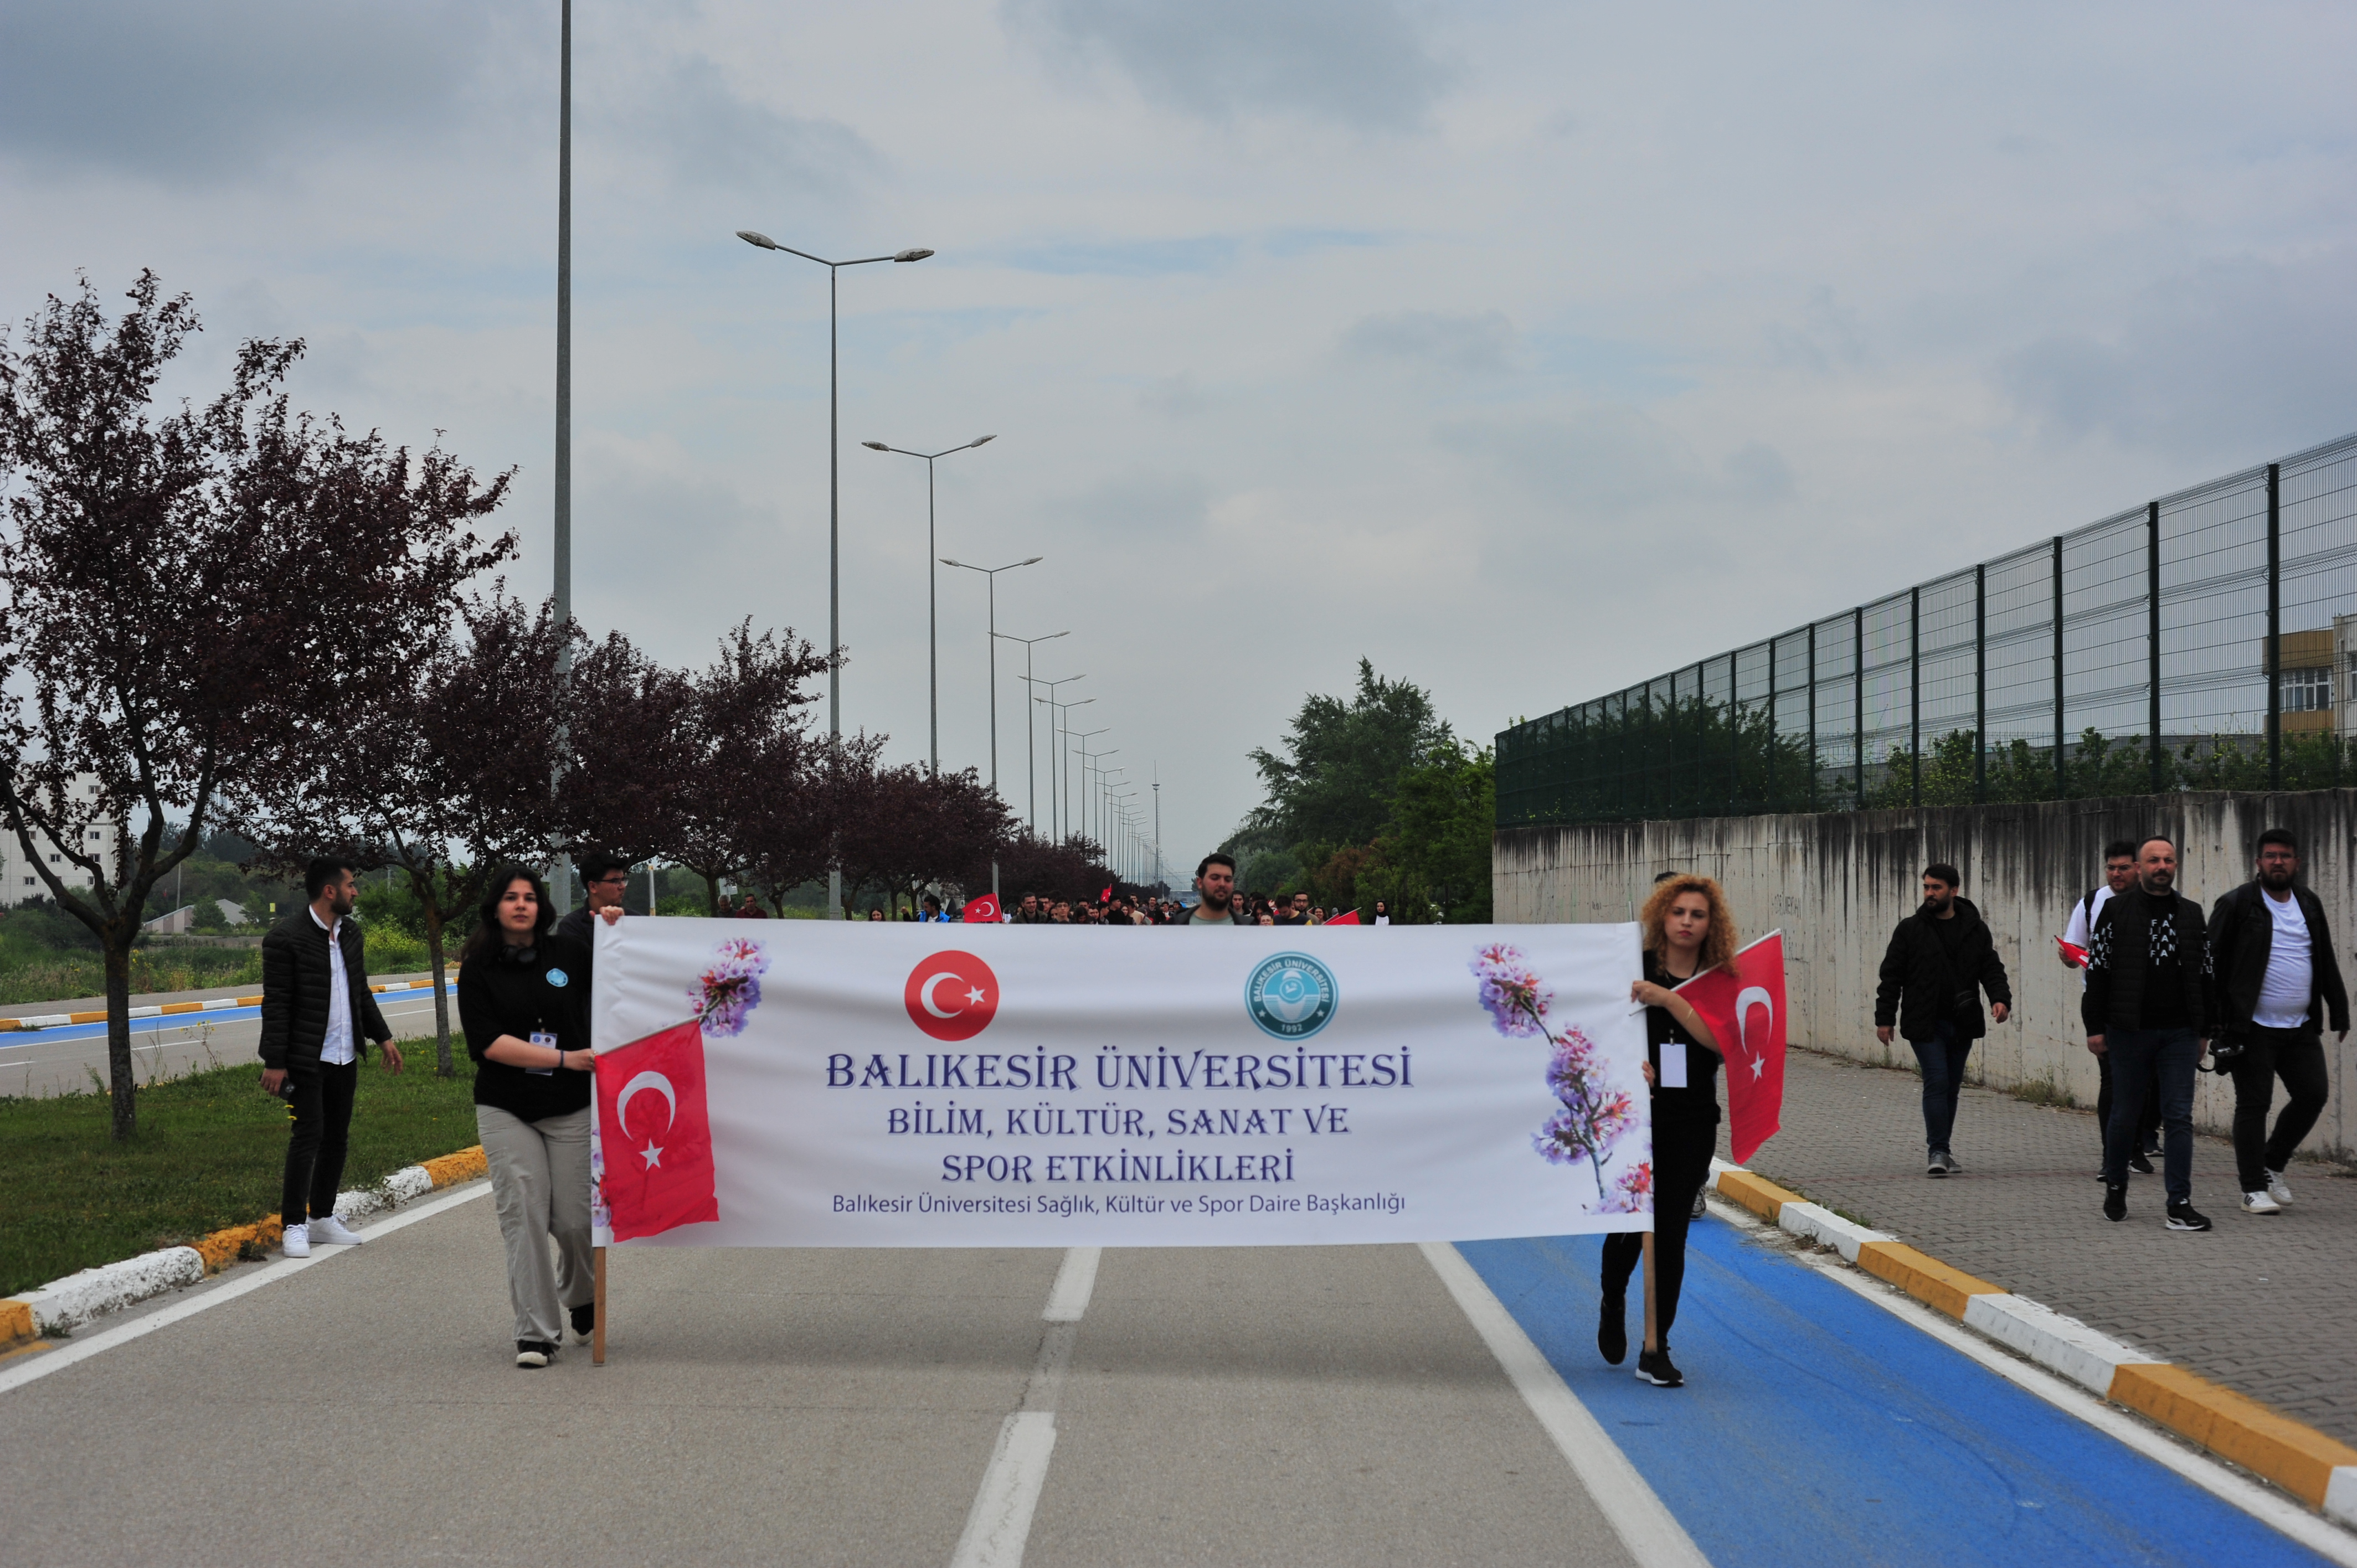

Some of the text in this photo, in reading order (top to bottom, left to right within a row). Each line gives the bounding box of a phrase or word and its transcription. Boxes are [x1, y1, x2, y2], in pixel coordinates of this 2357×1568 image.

[1253, 961, 1283, 1002] BALIKESİR
[1281, 1024, 1304, 1033] 1992
[826, 1045, 1414, 1091] BALIKESİR ÜNİVERSİTESİ
[888, 1100, 1351, 1139] BİLİM, KÜLTÜR, SANAT VE
[941, 1148, 1295, 1184] SPOR ETKİNLİKLERİ
[833, 1192, 1405, 1218] Balıkesir Üniversitesi Sağlık, Kültür ve Spor Daire Başkanlığı
